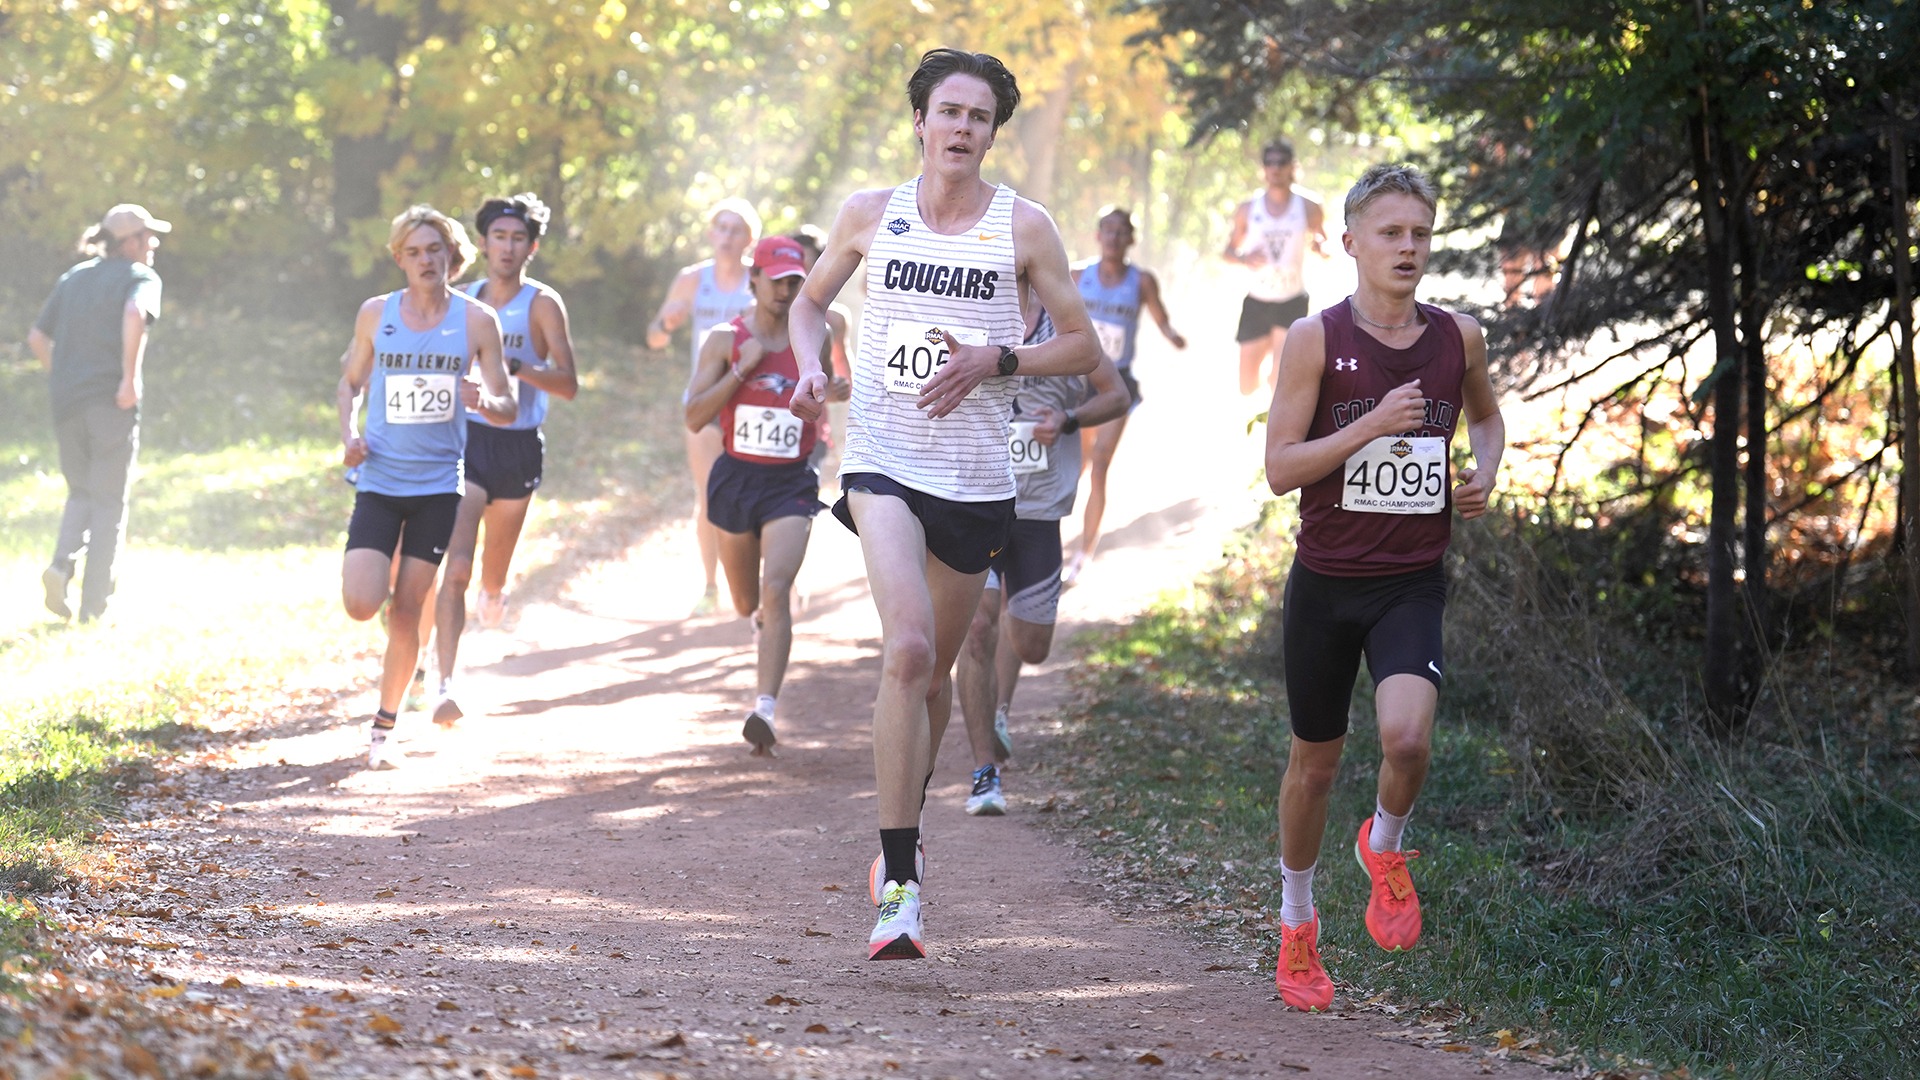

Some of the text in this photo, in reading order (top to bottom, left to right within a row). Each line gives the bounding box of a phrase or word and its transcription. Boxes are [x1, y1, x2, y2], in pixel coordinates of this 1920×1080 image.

[888, 221, 910, 232] RMAC
[884, 259, 999, 300] COUGARS
[379, 353, 461, 371] FORT LEWIS
[887, 344, 950, 379] 405
[894, 380, 914, 389] RMAC
[388, 389, 452, 412] 4129
[736, 421, 798, 448] 4146
[1010, 438, 1042, 463] 90
[1391, 444, 1413, 454] RMAC
[1346, 460, 1442, 497] 4095
[1354, 499, 1436, 508] RMAC CHAMPIONSHIP
